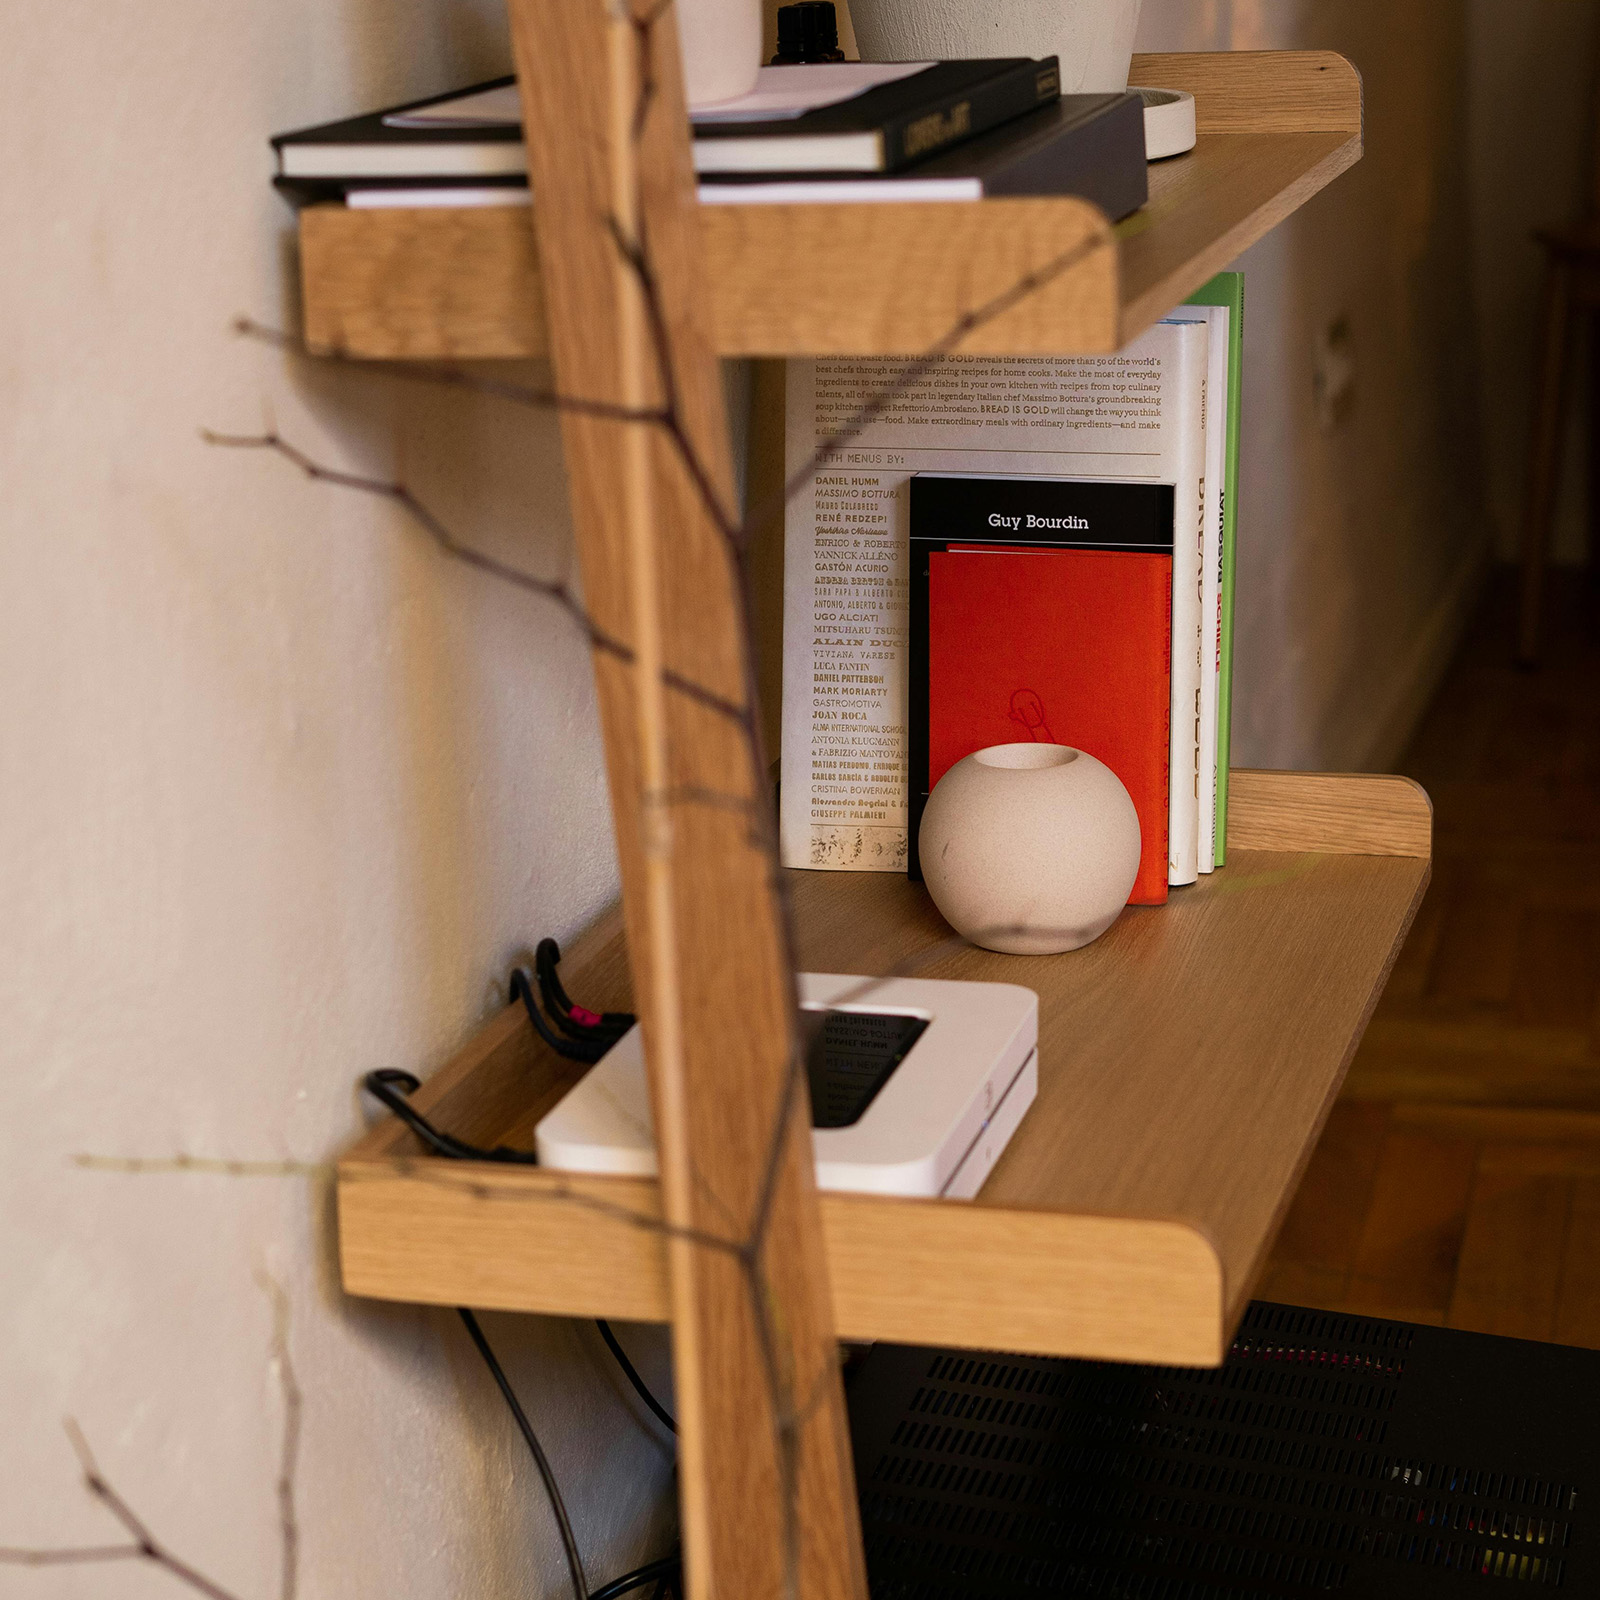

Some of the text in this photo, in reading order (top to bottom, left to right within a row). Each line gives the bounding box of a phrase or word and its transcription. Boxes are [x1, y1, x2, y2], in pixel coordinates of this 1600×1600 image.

[883, 354, 903, 362] food.
[904, 354, 934, 362] BREAD
[937, 354, 946, 362] IS
[948, 355, 974, 363] GOLD
[976, 356, 1002, 364] reveals
[1003, 356, 1016, 364] the
[1017, 357, 1044, 365] secrets
[1045, 357, 1054, 365] of
[1076, 357, 1095, 365] than
[1096, 359, 1106, 367] 50
[1108, 357, 1116, 365] of
[1131, 357, 1161, 366] world's
[834, 366, 854, 374] chefs
[856, 366, 887, 376] through
[889, 368, 905, 376] easy
[925, 367, 960, 377] inspiring
[961, 369, 988, 377] recipes
[991, 368, 1002, 376] for
[1004, 368, 1026, 376] home
[1028, 369, 1052, 377] cooks.
[1055, 369, 1077, 377] Make
[1079, 369, 1091, 377] the
[1117, 370, 1125, 378] of
[1127, 370, 1161, 380] everyday
[816, 378, 859, 387] ingredients
[934, 380, 959, 388] dishes
[961, 380, 969, 388] in
[970, 382, 988, 390] your
[1009, 381, 1038, 389] kitchen
[1040, 382, 1057, 390] with
[1060, 382, 1089, 392] recipes
[1091, 383, 1110, 391] from
[1113, 383, 1126, 392] top
[1128, 383, 1161, 393] culinary
[815, 390, 844, 399] talents,
[846, 391, 855, 399] all
[856, 391, 865, 399] of
[866, 391, 890, 399] whom
[911, 393, 927, 401] part
[928, 392, 936, 400] in
[938, 392, 975, 402] legendary
[977, 393, 1002, 401] Italian
[1004, 393, 1021, 401] chef
[1022, 394, 1057, 402] Massimo
[1059, 394, 1095, 403] Bottura's
[1096, 395, 1161, 405] groundbreaking
[815, 403, 1161, 418] soup kitchen project Refettorio Ambrosiano. BREAD IS GOLD will change the way you think
[931, 417, 983, 427] extraordinary
[985, 418, 1008, 426] meals
[1011, 419, 1028, 427] with
[1030, 419, 1064, 429] ordinary
[1138, 421, 1161, 429] make
[821, 428, 862, 436] difference.
[815, 453, 904, 464] WITH MENUS BY:
[815, 477, 879, 486] DANIEL HUMM
[815, 489, 901, 499] MASSIMO BOTTURA
[815, 513, 887, 523] RENÉ REDZEPI
[988, 513, 1089, 531] Guy Bourdin
[815, 538, 850, 547] ENRICO
[864, 540, 907, 549] ROBERTO
[814, 551, 899, 561] YANNICK ALLÉNO
[815, 562, 889, 573] GASTÓN ACURIO
[835, 588, 852, 596] PAPA
[863, 589, 894, 598] ALBERTO
[814, 600, 877, 610] ANTONIO, ALBERTO
[814, 613, 879, 622] UGO ALCIATI
[814, 625, 871, 635] MITSUHARU
[813, 638, 865, 647] ALAIN
[813, 650, 896, 660] VIVIANA VARESE
[814, 662, 870, 671] LUCA FANTIN
[814, 674, 884, 684] DANIEL PATTERSON
[813, 687, 888, 696] MARK MORIARTY
[813, 699, 882, 709] GASTROMOTIVA
[812, 711, 867, 720] JOAN ROCA
[812, 723, 829, 732] ALMA
[831, 723, 880, 733] INTERNATIONAL
[811, 736, 900, 746] ANTONIA KLUGMANN
[818, 748, 858, 757] FABRIZIO
[811, 760, 837, 769] MATIAS
[873, 762, 900, 771] ENRIQUE
[811, 773, 836, 781] CARLOS
[811, 785, 900, 796] CRISTINA BOWERMAN
[811, 797, 856, 807] Alessandro
[811, 810, 886, 819] GIUSEPPE PALMIERI
